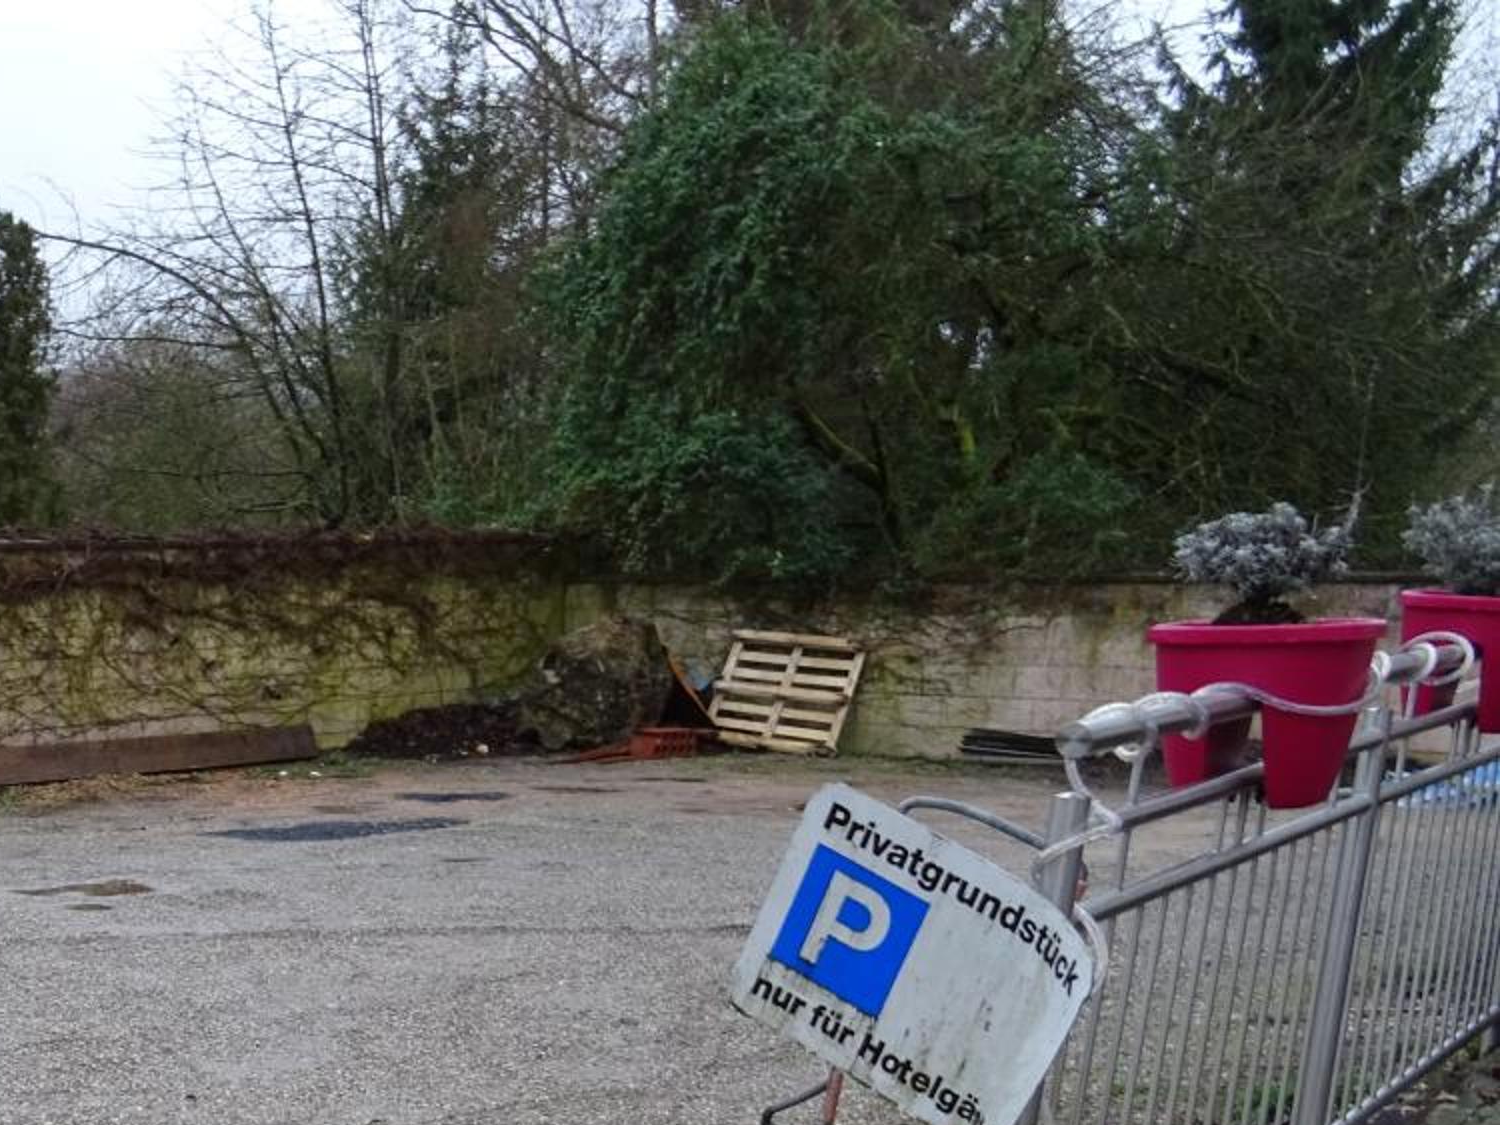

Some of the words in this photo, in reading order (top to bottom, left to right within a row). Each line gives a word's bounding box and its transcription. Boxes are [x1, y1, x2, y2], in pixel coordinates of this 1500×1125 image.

[800, 869, 892, 964] P
[824, 803, 1079, 996] Privatgrundstück
[751, 977, 807, 1015] nur
[810, 1004, 855, 1045] für
